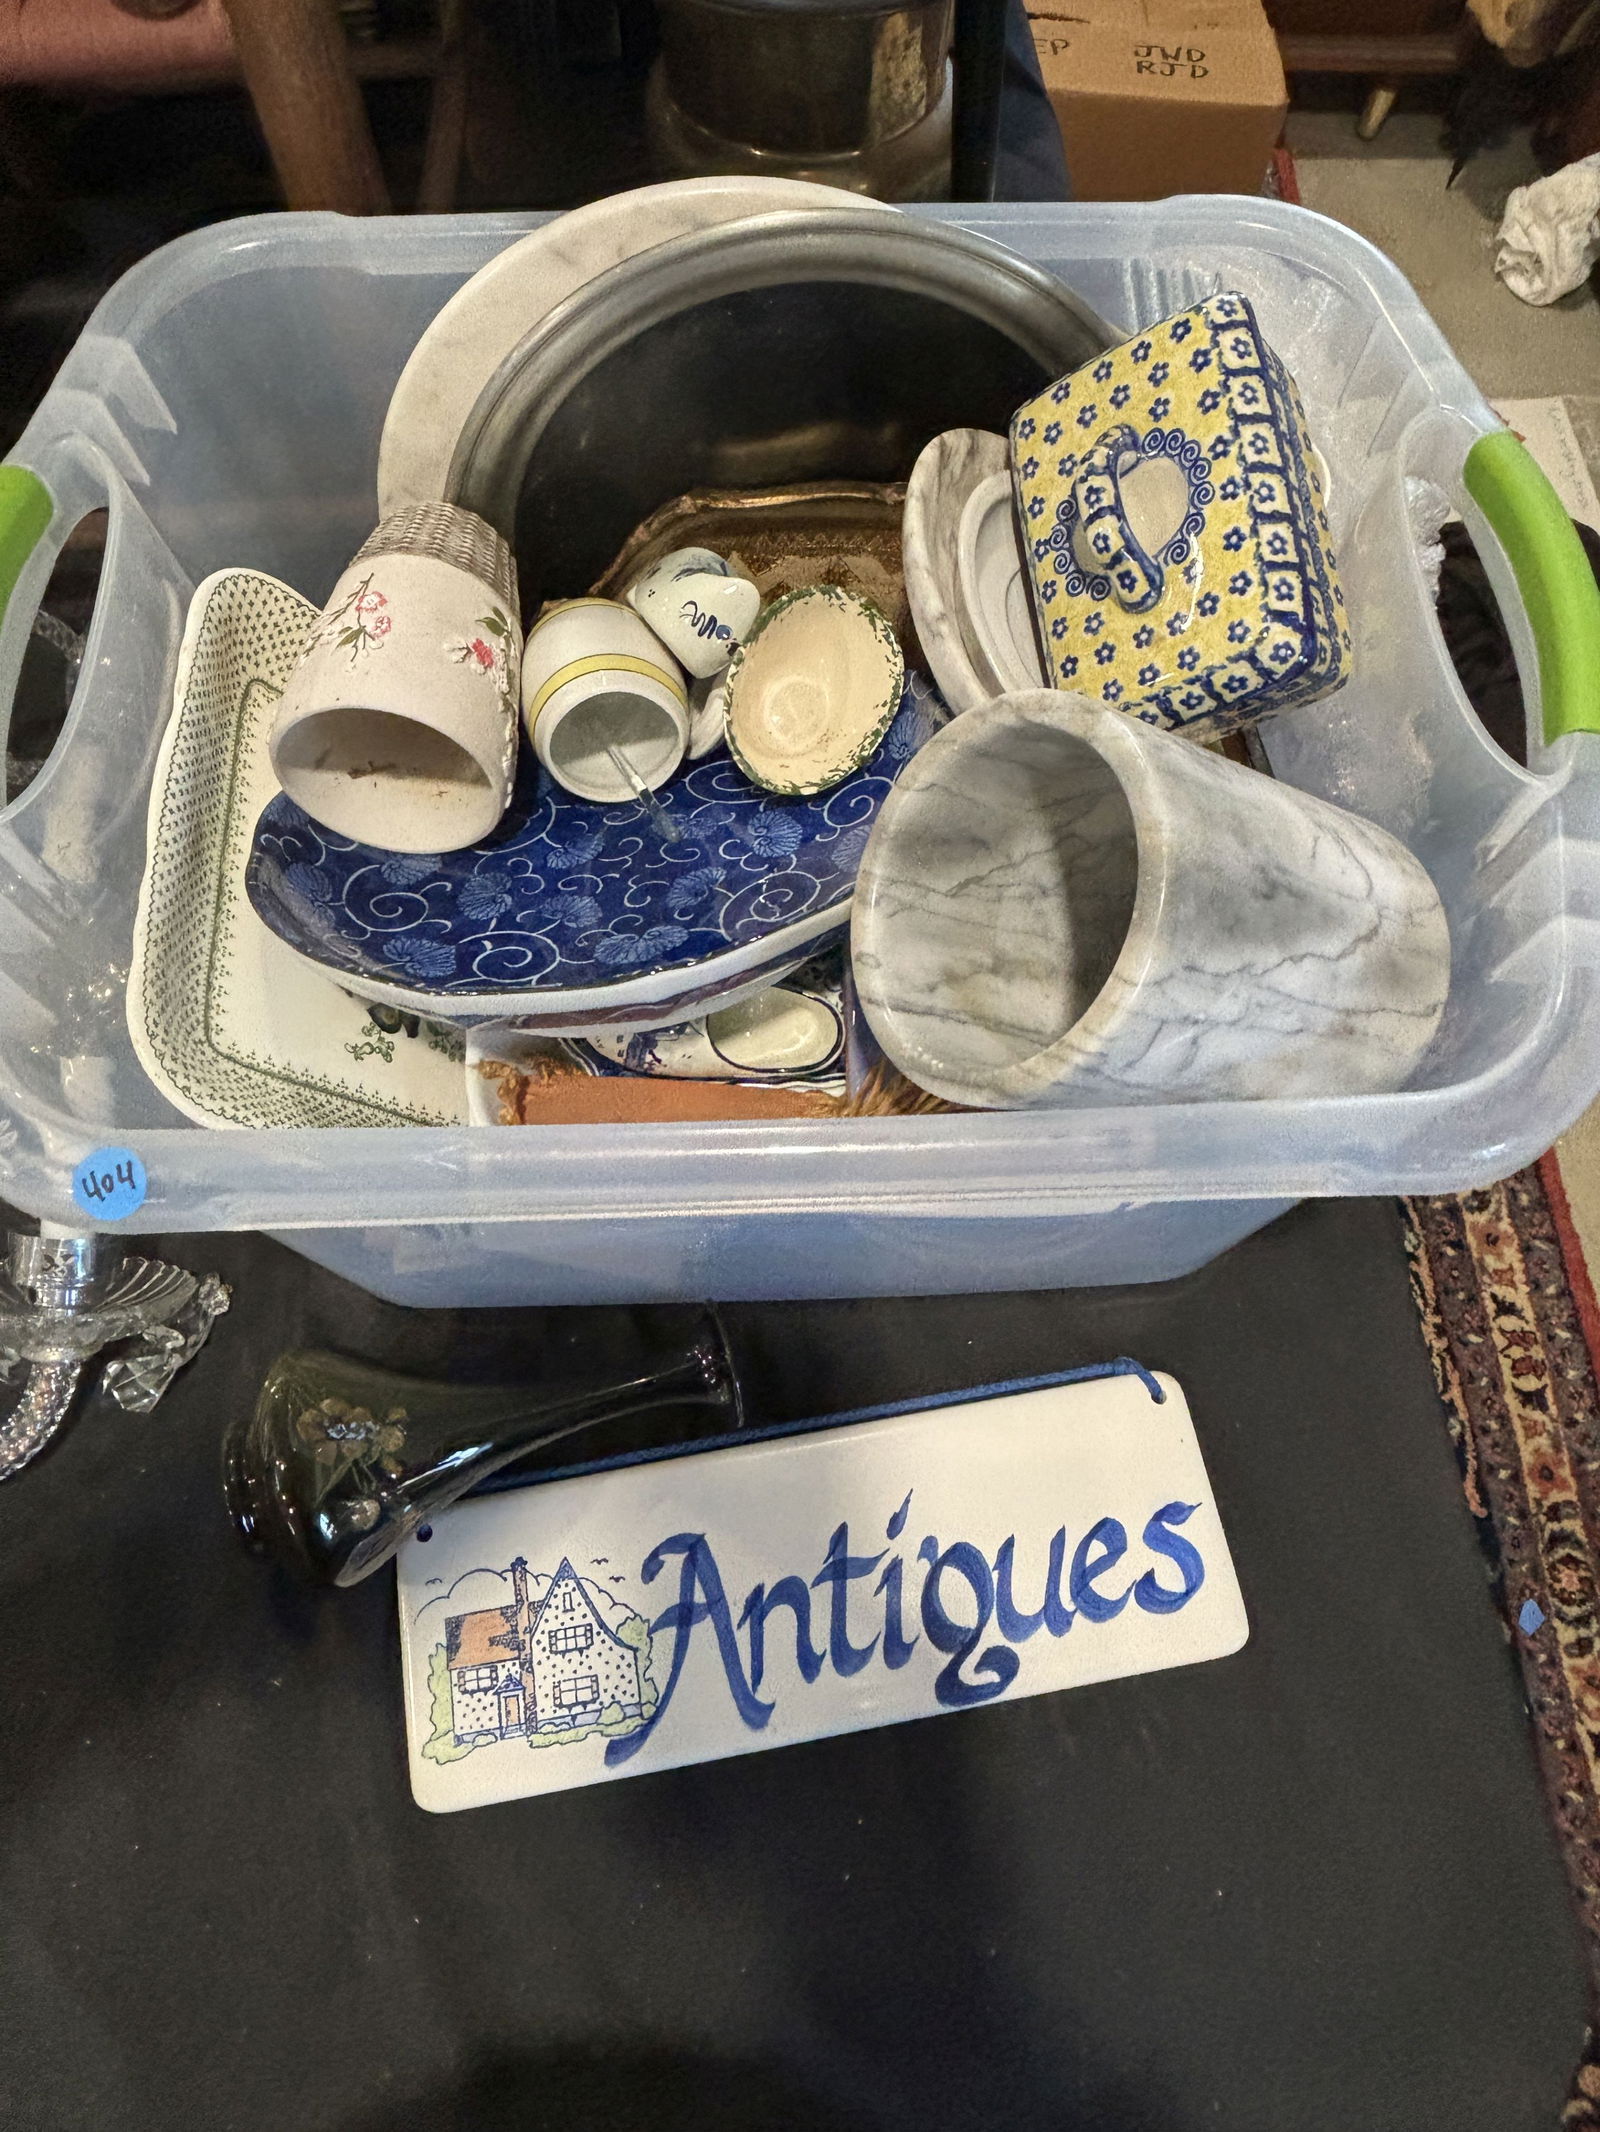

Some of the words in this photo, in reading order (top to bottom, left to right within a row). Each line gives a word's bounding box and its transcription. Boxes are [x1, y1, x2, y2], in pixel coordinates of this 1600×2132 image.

[1134, 45, 1206, 62] JWD
[1136, 60, 1209, 79] RJD
[81, 1160, 136, 1202] 404
[604, 1488, 1205, 1767] Antiques
